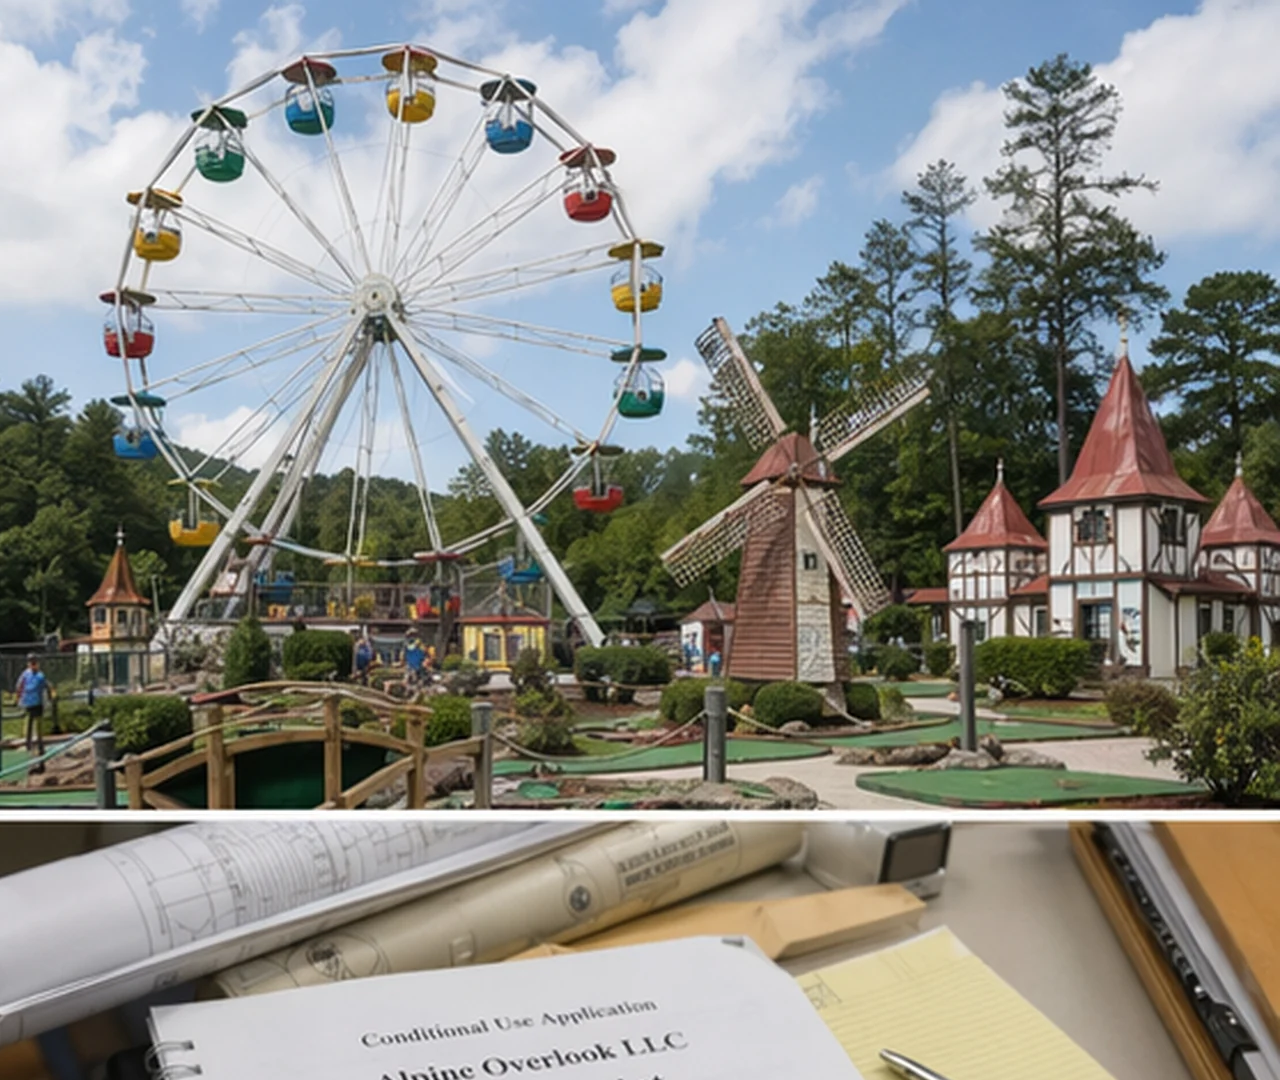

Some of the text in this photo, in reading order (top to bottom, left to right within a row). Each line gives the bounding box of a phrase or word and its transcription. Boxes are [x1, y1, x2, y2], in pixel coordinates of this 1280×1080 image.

[360, 1000, 657, 1048] Conditional Use Application
[481, 1043, 617, 1077] Overlook
[621, 1031, 689, 1057] LLC
